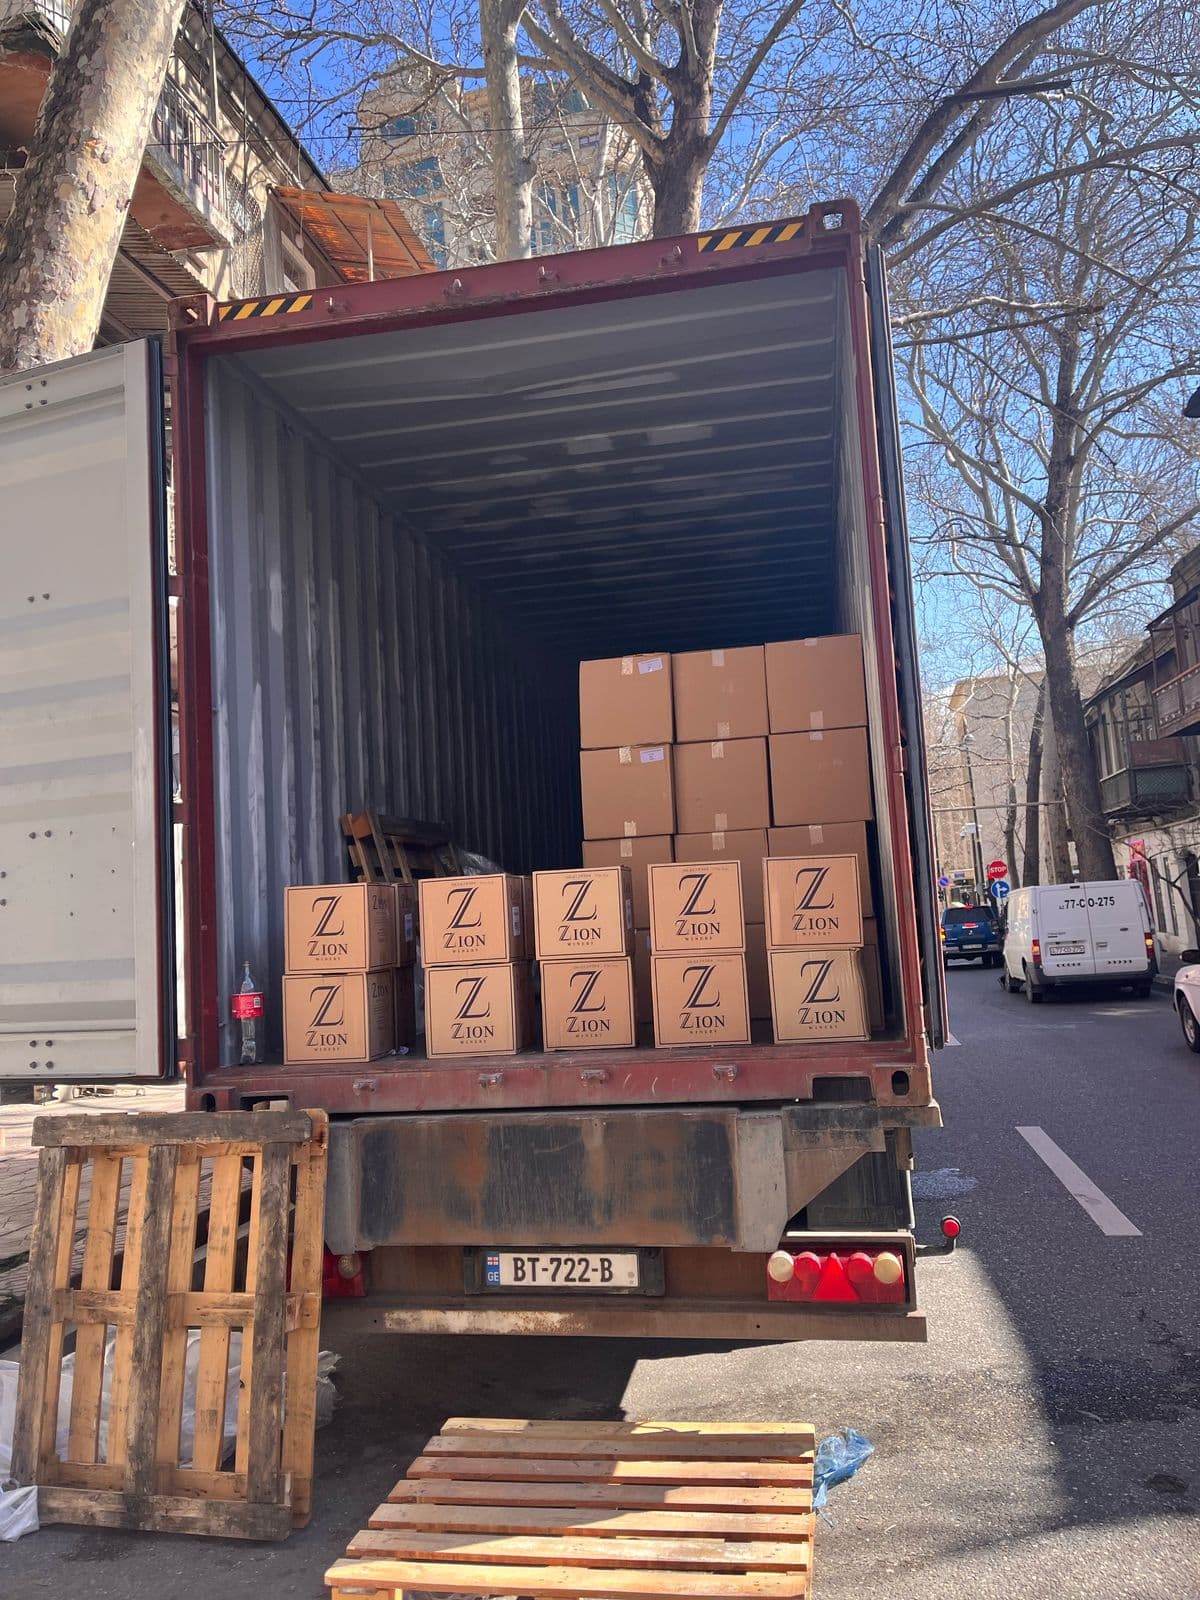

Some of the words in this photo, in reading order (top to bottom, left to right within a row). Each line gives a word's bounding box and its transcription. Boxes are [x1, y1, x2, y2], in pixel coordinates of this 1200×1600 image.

[990, 866, 1007, 874] STOP
[678, 872, 715, 916] Z
[796, 867, 834, 911] Z
[447, 887, 482, 929] Z
[562, 879, 597, 921] Z
[312, 896, 344, 937] Z
[792, 913, 839, 930] ZION
[558, 925, 601, 941] ZION
[675, 919, 720, 936] ZION
[307, 940, 348, 956] ZION
[443, 932, 486, 948] ZION
[682, 965, 720, 1009] Z
[801, 959, 840, 1004] Z
[455, 976, 490, 1019] Z
[569, 969, 606, 1012] Z
[309, 984, 344, 1027] Z
[566, 1016, 610, 1032] ZION
[679, 1012, 725, 1028] ZION
[798, 1008, 846, 1024] ZION
[305, 1030, 348, 1046] ZION
[451, 1023, 494, 1039] ZION
[487, 1271, 499, 1282] GE
[512, 1257, 613, 1283] BT-722-B
